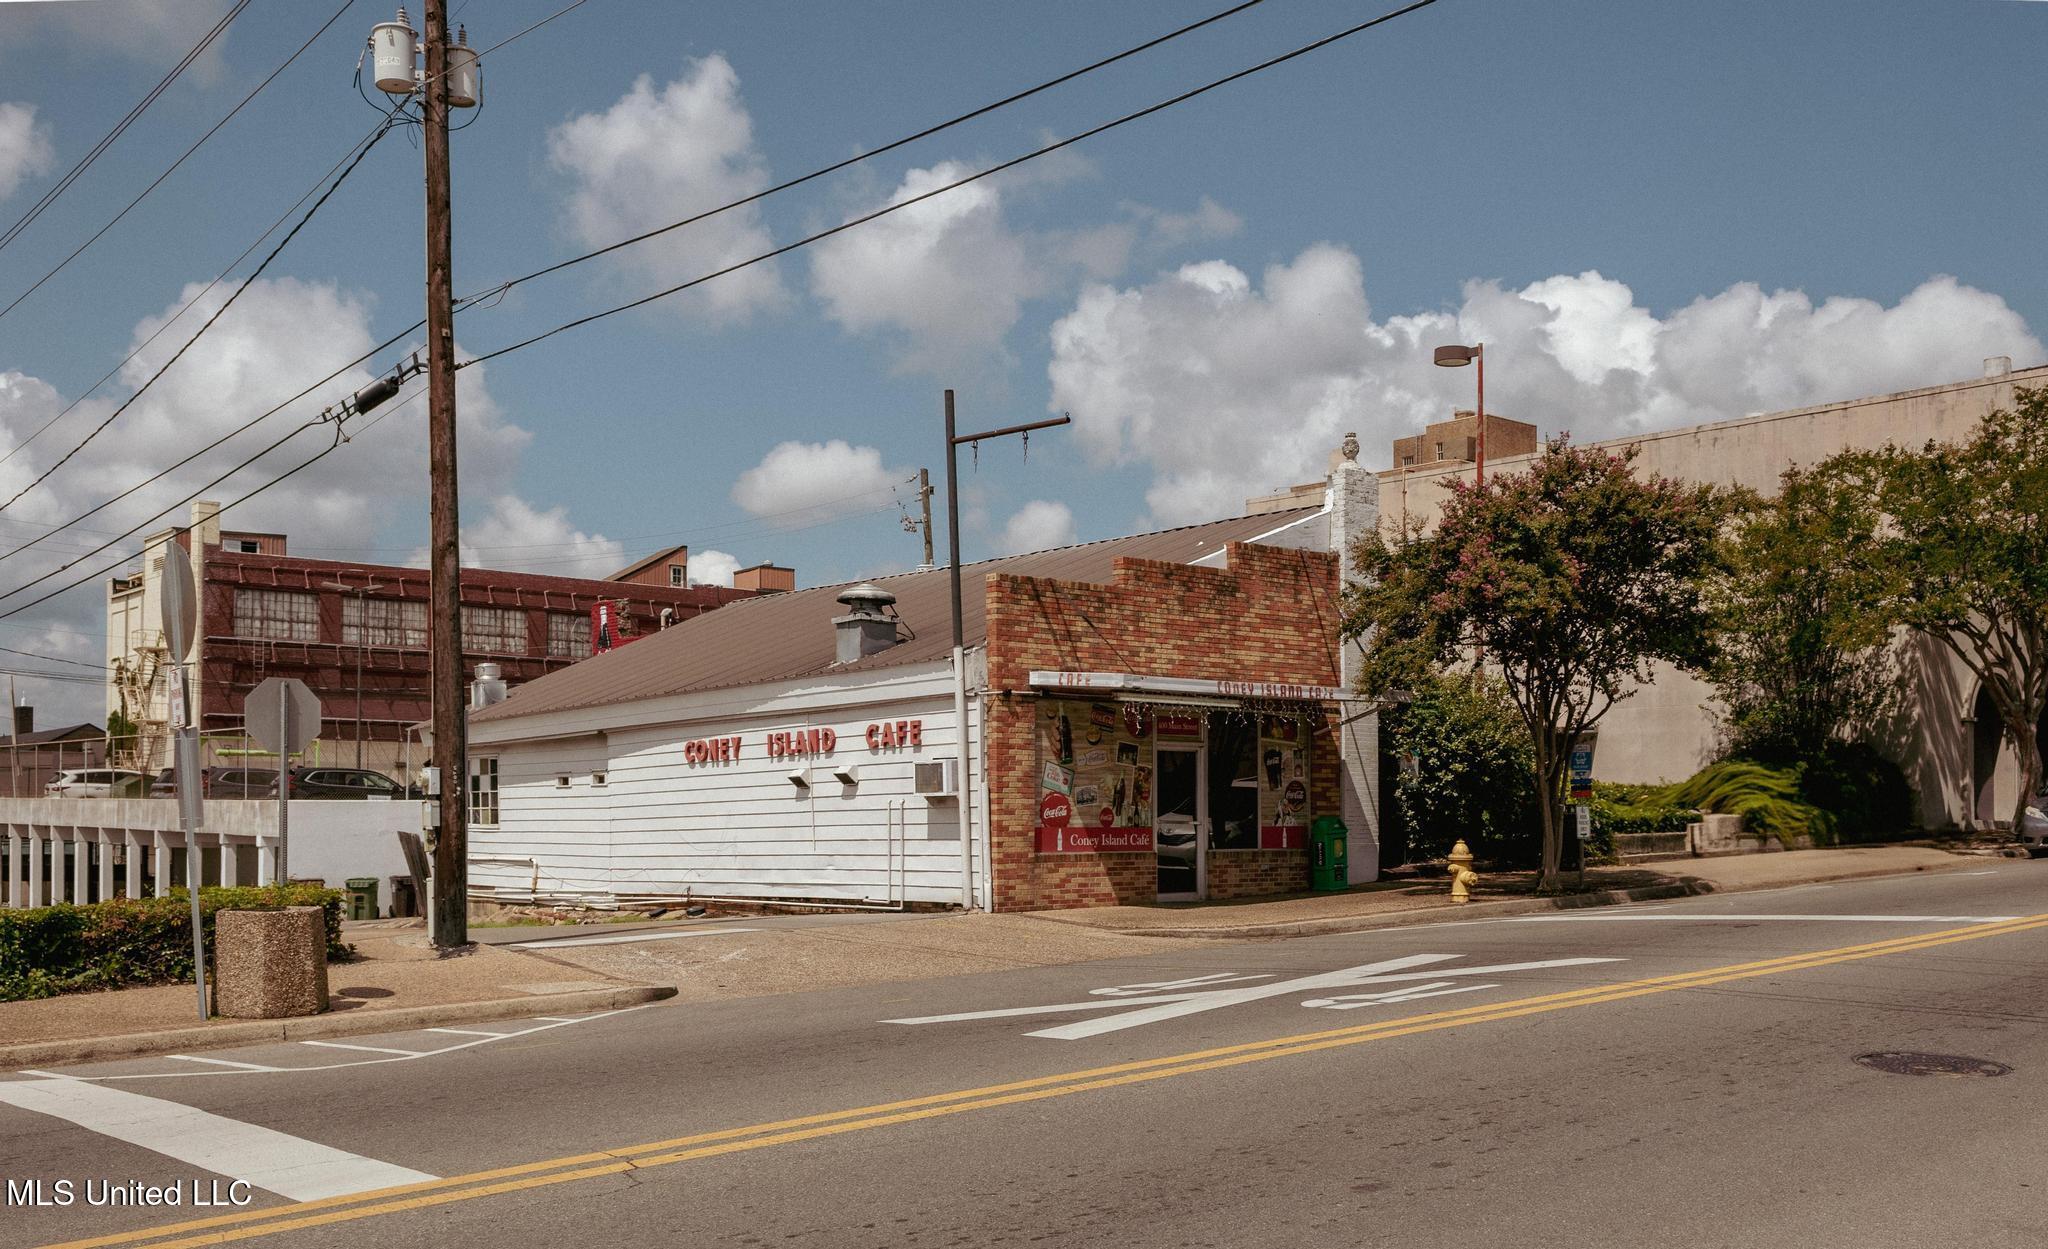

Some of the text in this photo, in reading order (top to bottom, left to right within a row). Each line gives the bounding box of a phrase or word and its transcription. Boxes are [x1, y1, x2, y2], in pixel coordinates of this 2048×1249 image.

[1058, 673, 1091, 688] CAFE
[1217, 681, 1254, 696] CONEY
[1261, 683, 1303, 699] ISLAND
[684, 719, 923, 764] CONEY ISLAND CAFE
[1043, 805, 1068, 819] Coca-Cola
[1070, 833, 1150, 848] Coney Island Café
